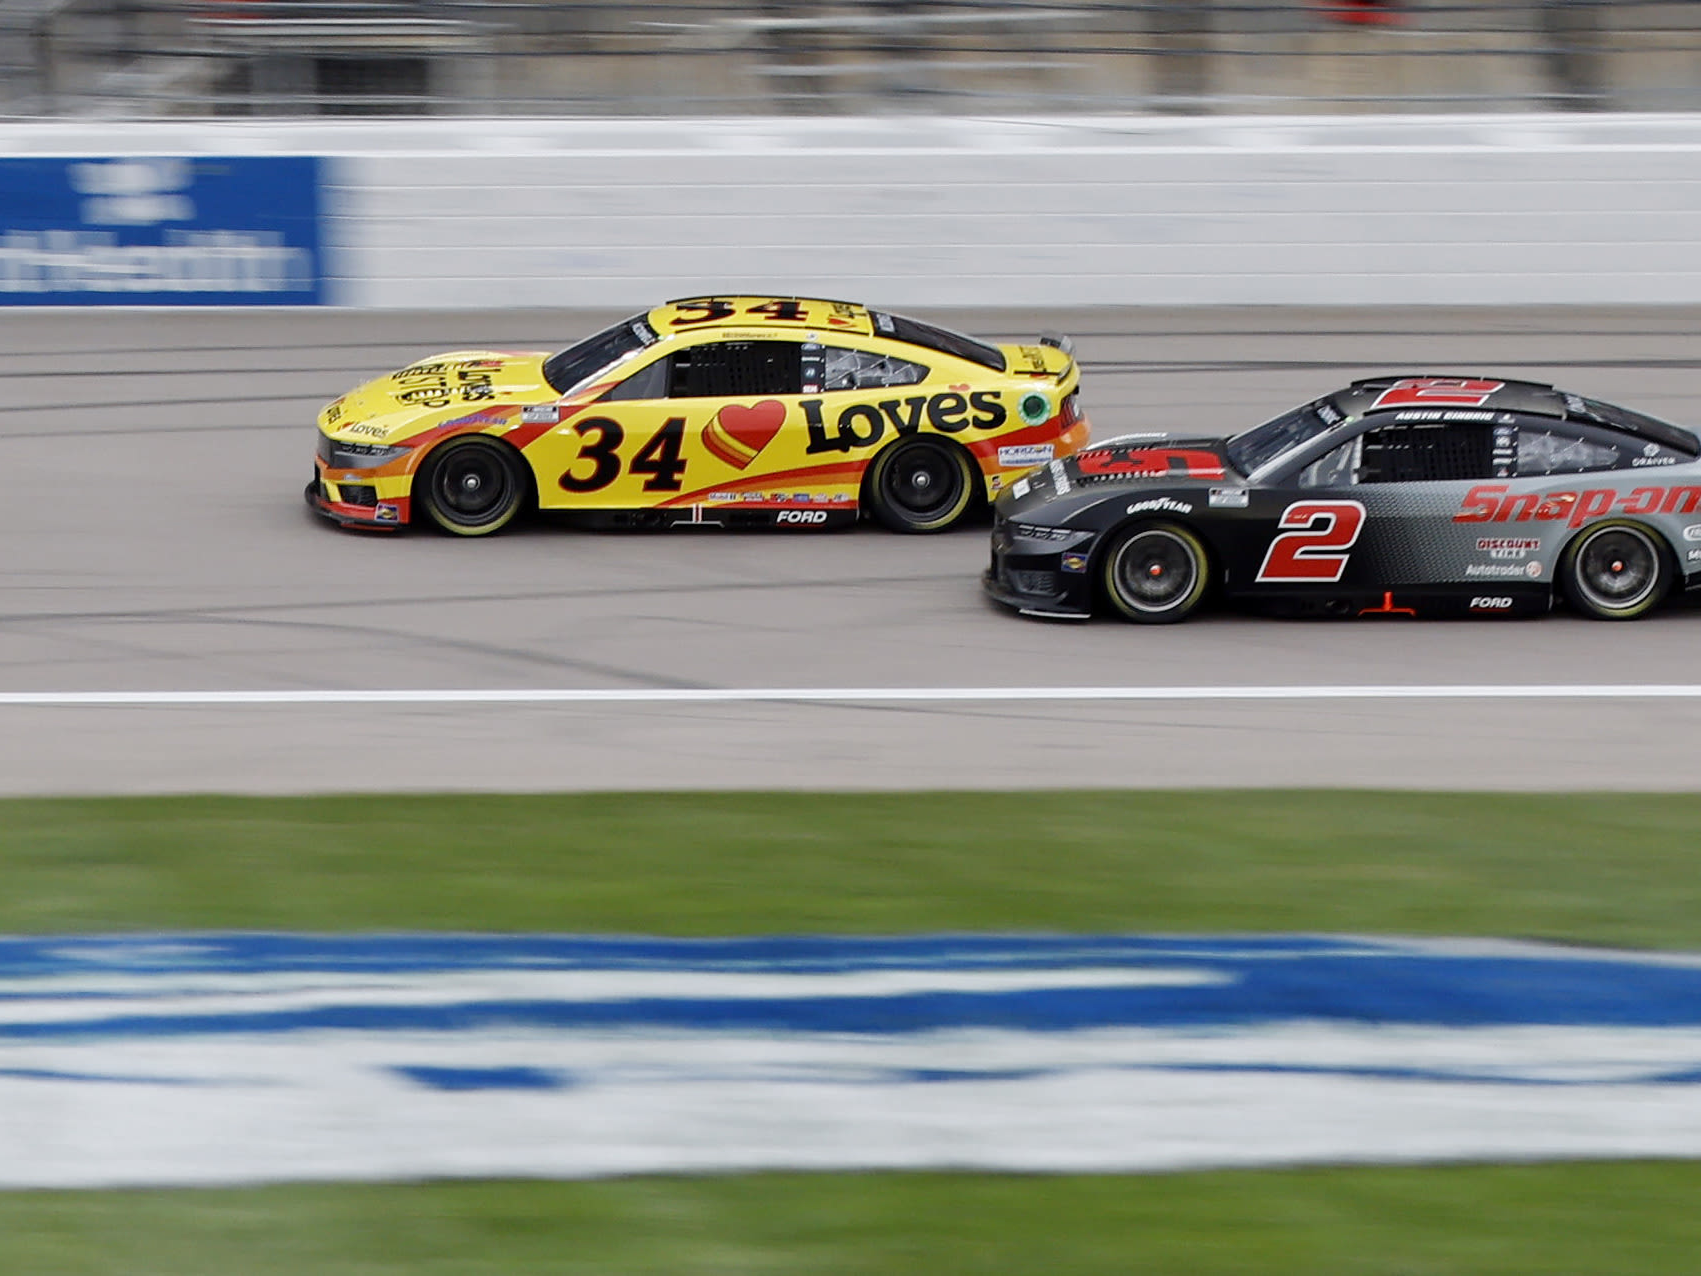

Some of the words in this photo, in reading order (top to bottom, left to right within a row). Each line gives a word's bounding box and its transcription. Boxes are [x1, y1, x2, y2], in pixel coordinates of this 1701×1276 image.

[671, 299, 810, 326] 34
[1369, 378, 1505, 410] 2
[1395, 411, 1443, 420] AUSTIN
[1443, 411, 1495, 420] CINDRIC
[558, 417, 689, 494] 34
[1126, 497, 1193, 515] GOODYEAR
[776, 511, 827, 523] FORD
[1255, 499, 1367, 583] 2
[1477, 538, 1540, 550] DISCOUNT
[1465, 564, 1526, 576] Autotrader
[1470, 597, 1513, 607] FORD
